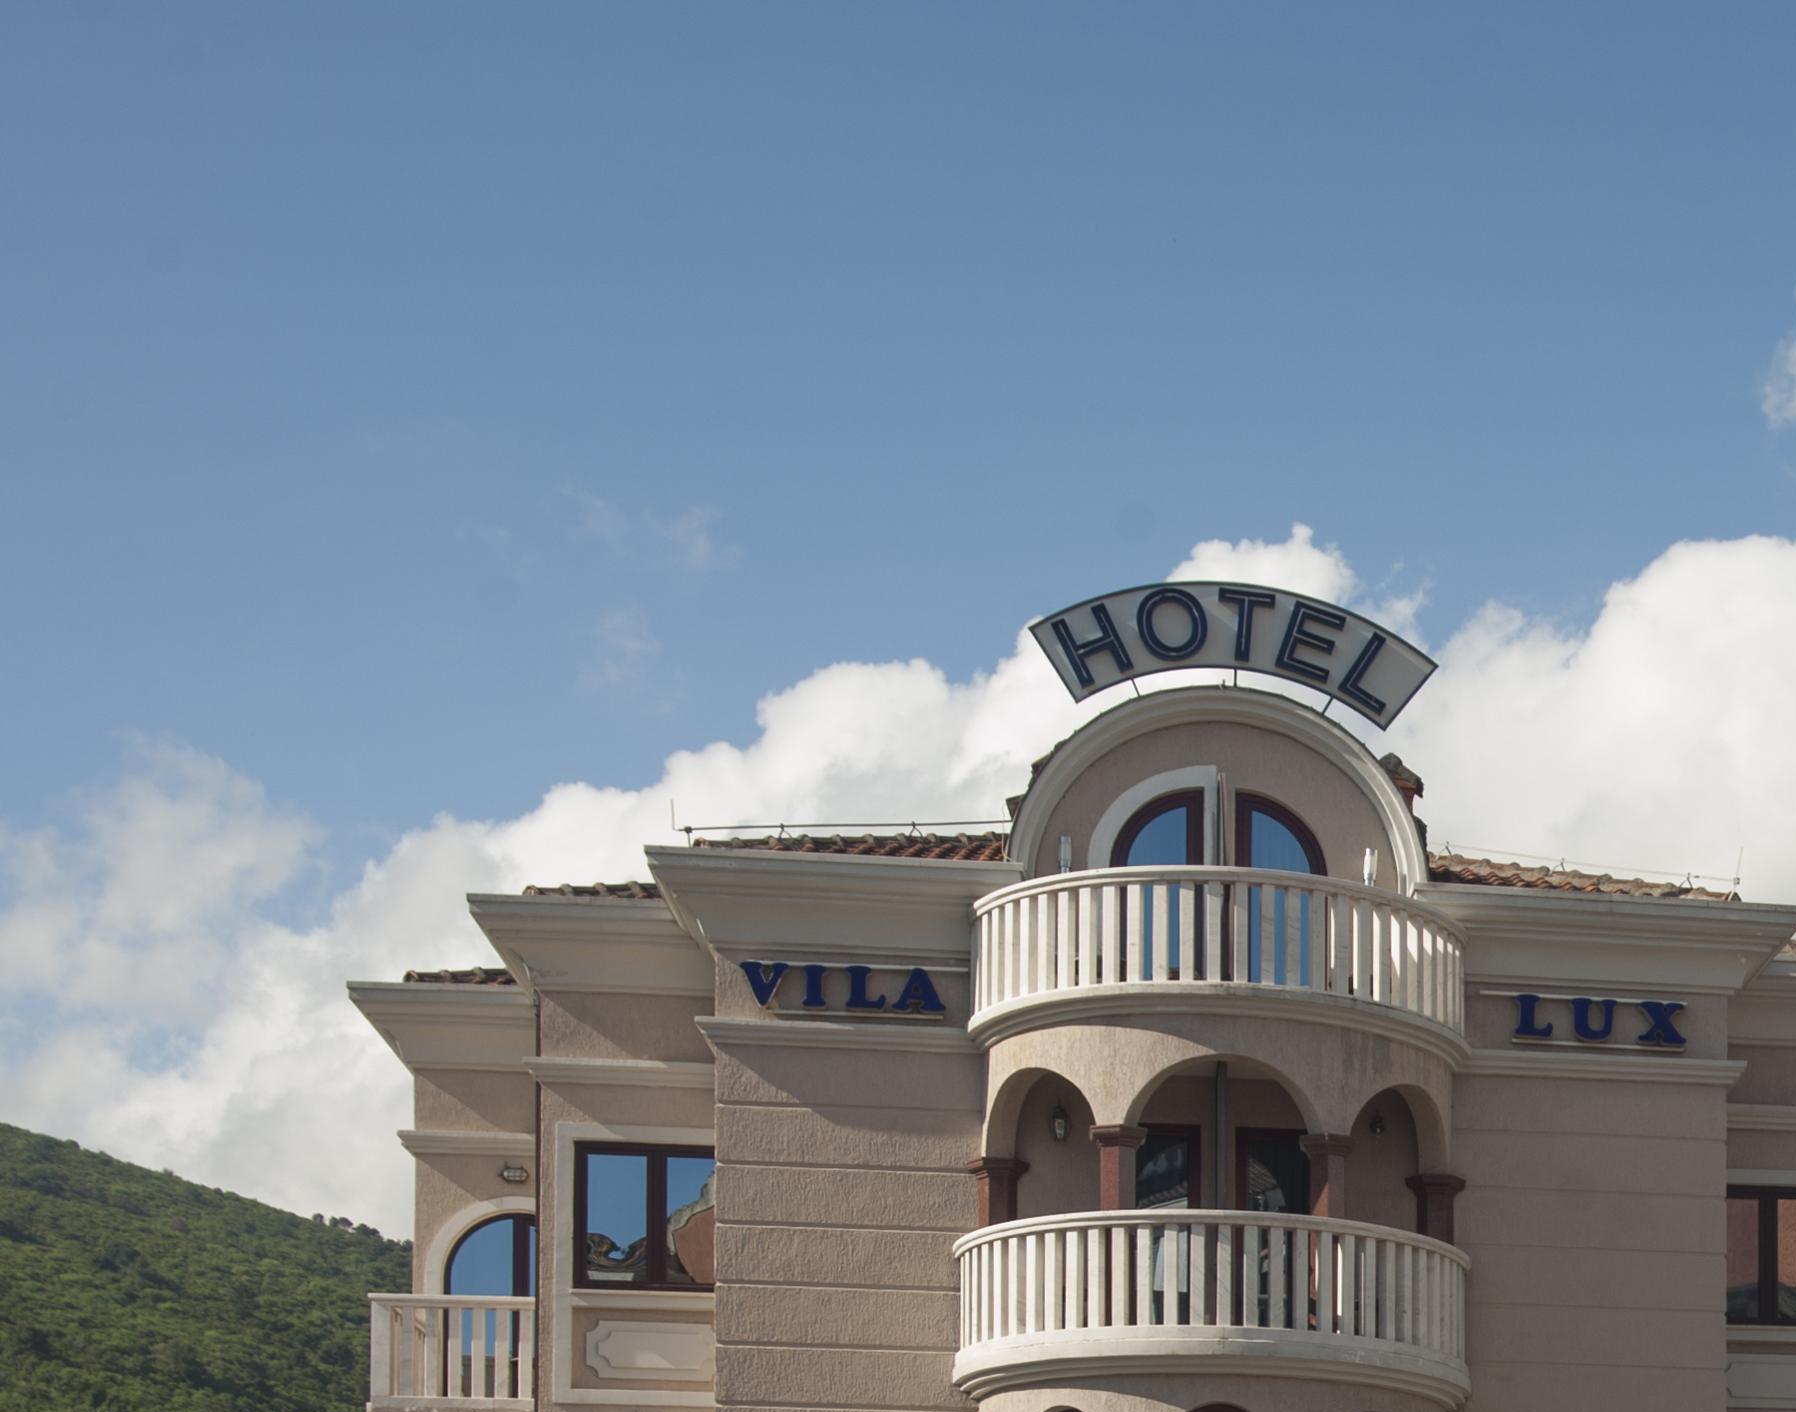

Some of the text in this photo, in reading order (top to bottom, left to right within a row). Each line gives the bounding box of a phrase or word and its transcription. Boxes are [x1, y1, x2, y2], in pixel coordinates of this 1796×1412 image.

[1051, 587, 1387, 715] HOTEL
[739, 960, 946, 1013] VILA
[1513, 993, 1687, 1045] LUX
